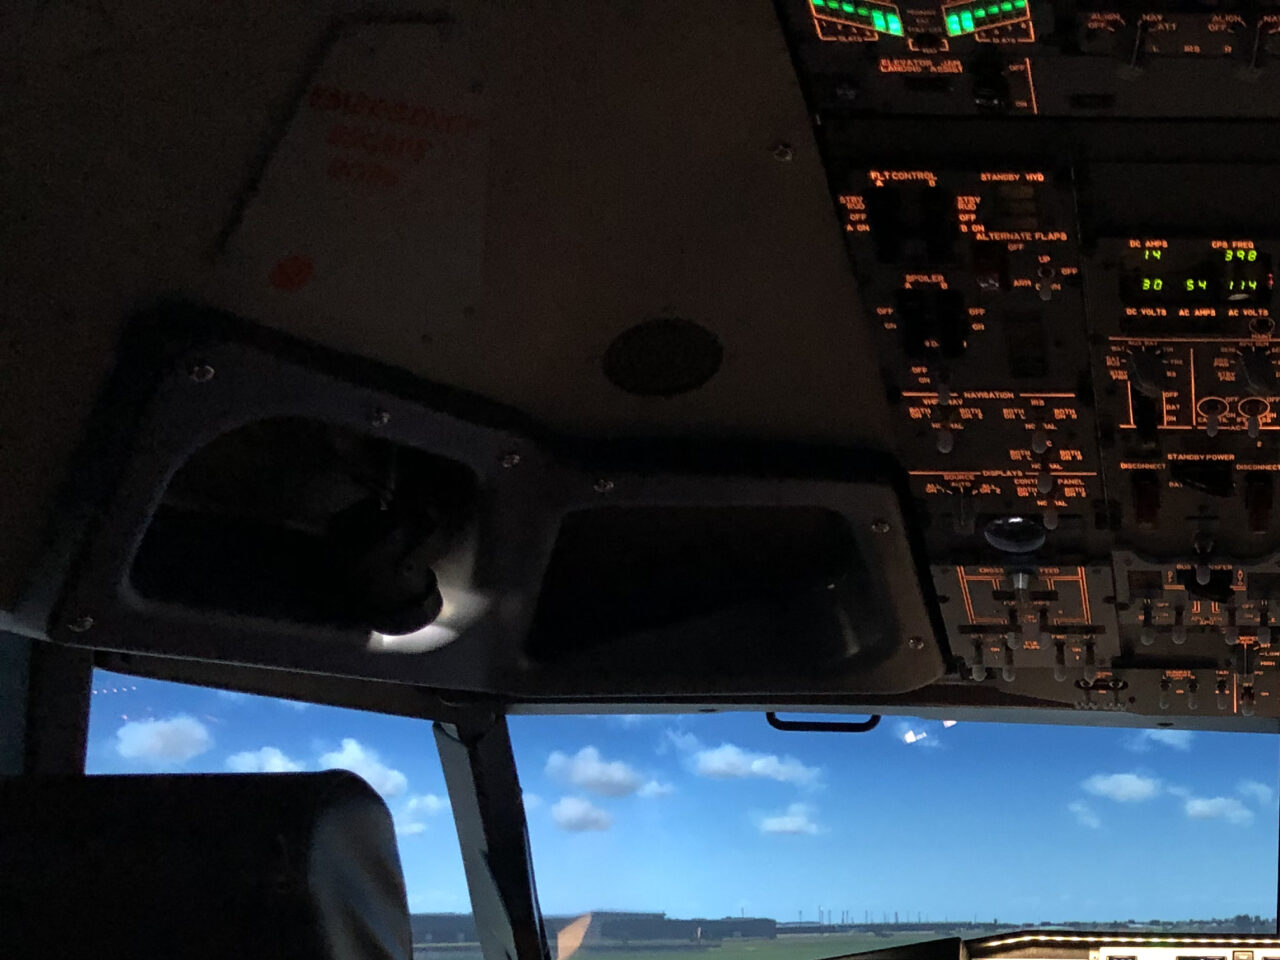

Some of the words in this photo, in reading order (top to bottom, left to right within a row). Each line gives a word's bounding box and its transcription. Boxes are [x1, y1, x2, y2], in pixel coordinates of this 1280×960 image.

[892, 172, 937, 180] CONTROL
[1130, 240, 1141, 248] DC
[1145, 240, 1168, 248] AMPS
[1145, 250, 1161, 260] 14
[1225, 250, 1257, 262] 398
[1142, 279, 1163, 290] 30
[1186, 279, 1207, 290] 54
[1229, 281, 1257, 290] 114
[1243, 309, 1269, 317] VOLTS
